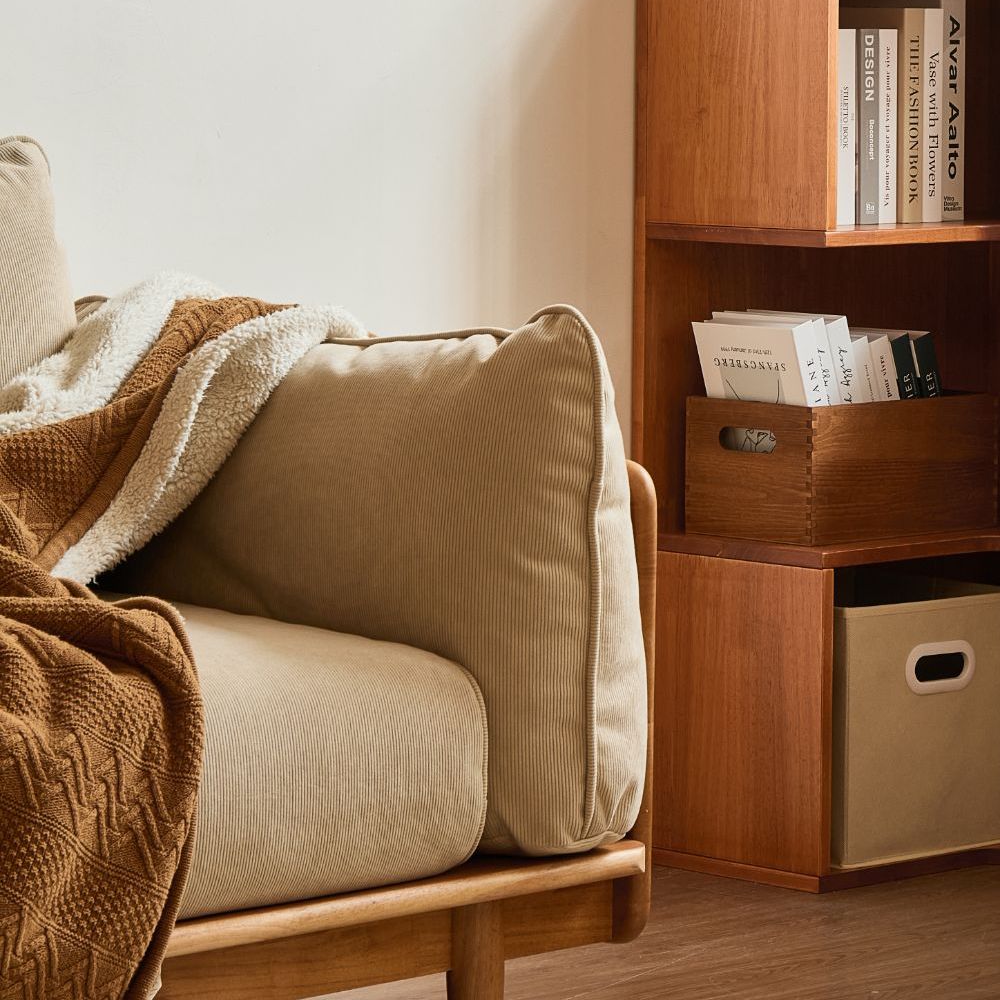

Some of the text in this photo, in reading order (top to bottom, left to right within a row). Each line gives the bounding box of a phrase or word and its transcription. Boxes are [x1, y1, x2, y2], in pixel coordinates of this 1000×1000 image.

[864, 34, 875, 101] DESIGN
[908, 36, 919, 204] THE FASHION BOOK
[928, 52, 940, 198] Vase with Flowers
[948, 15, 960, 180] Alvar Aalto
[883, 378, 893, 399] pour
